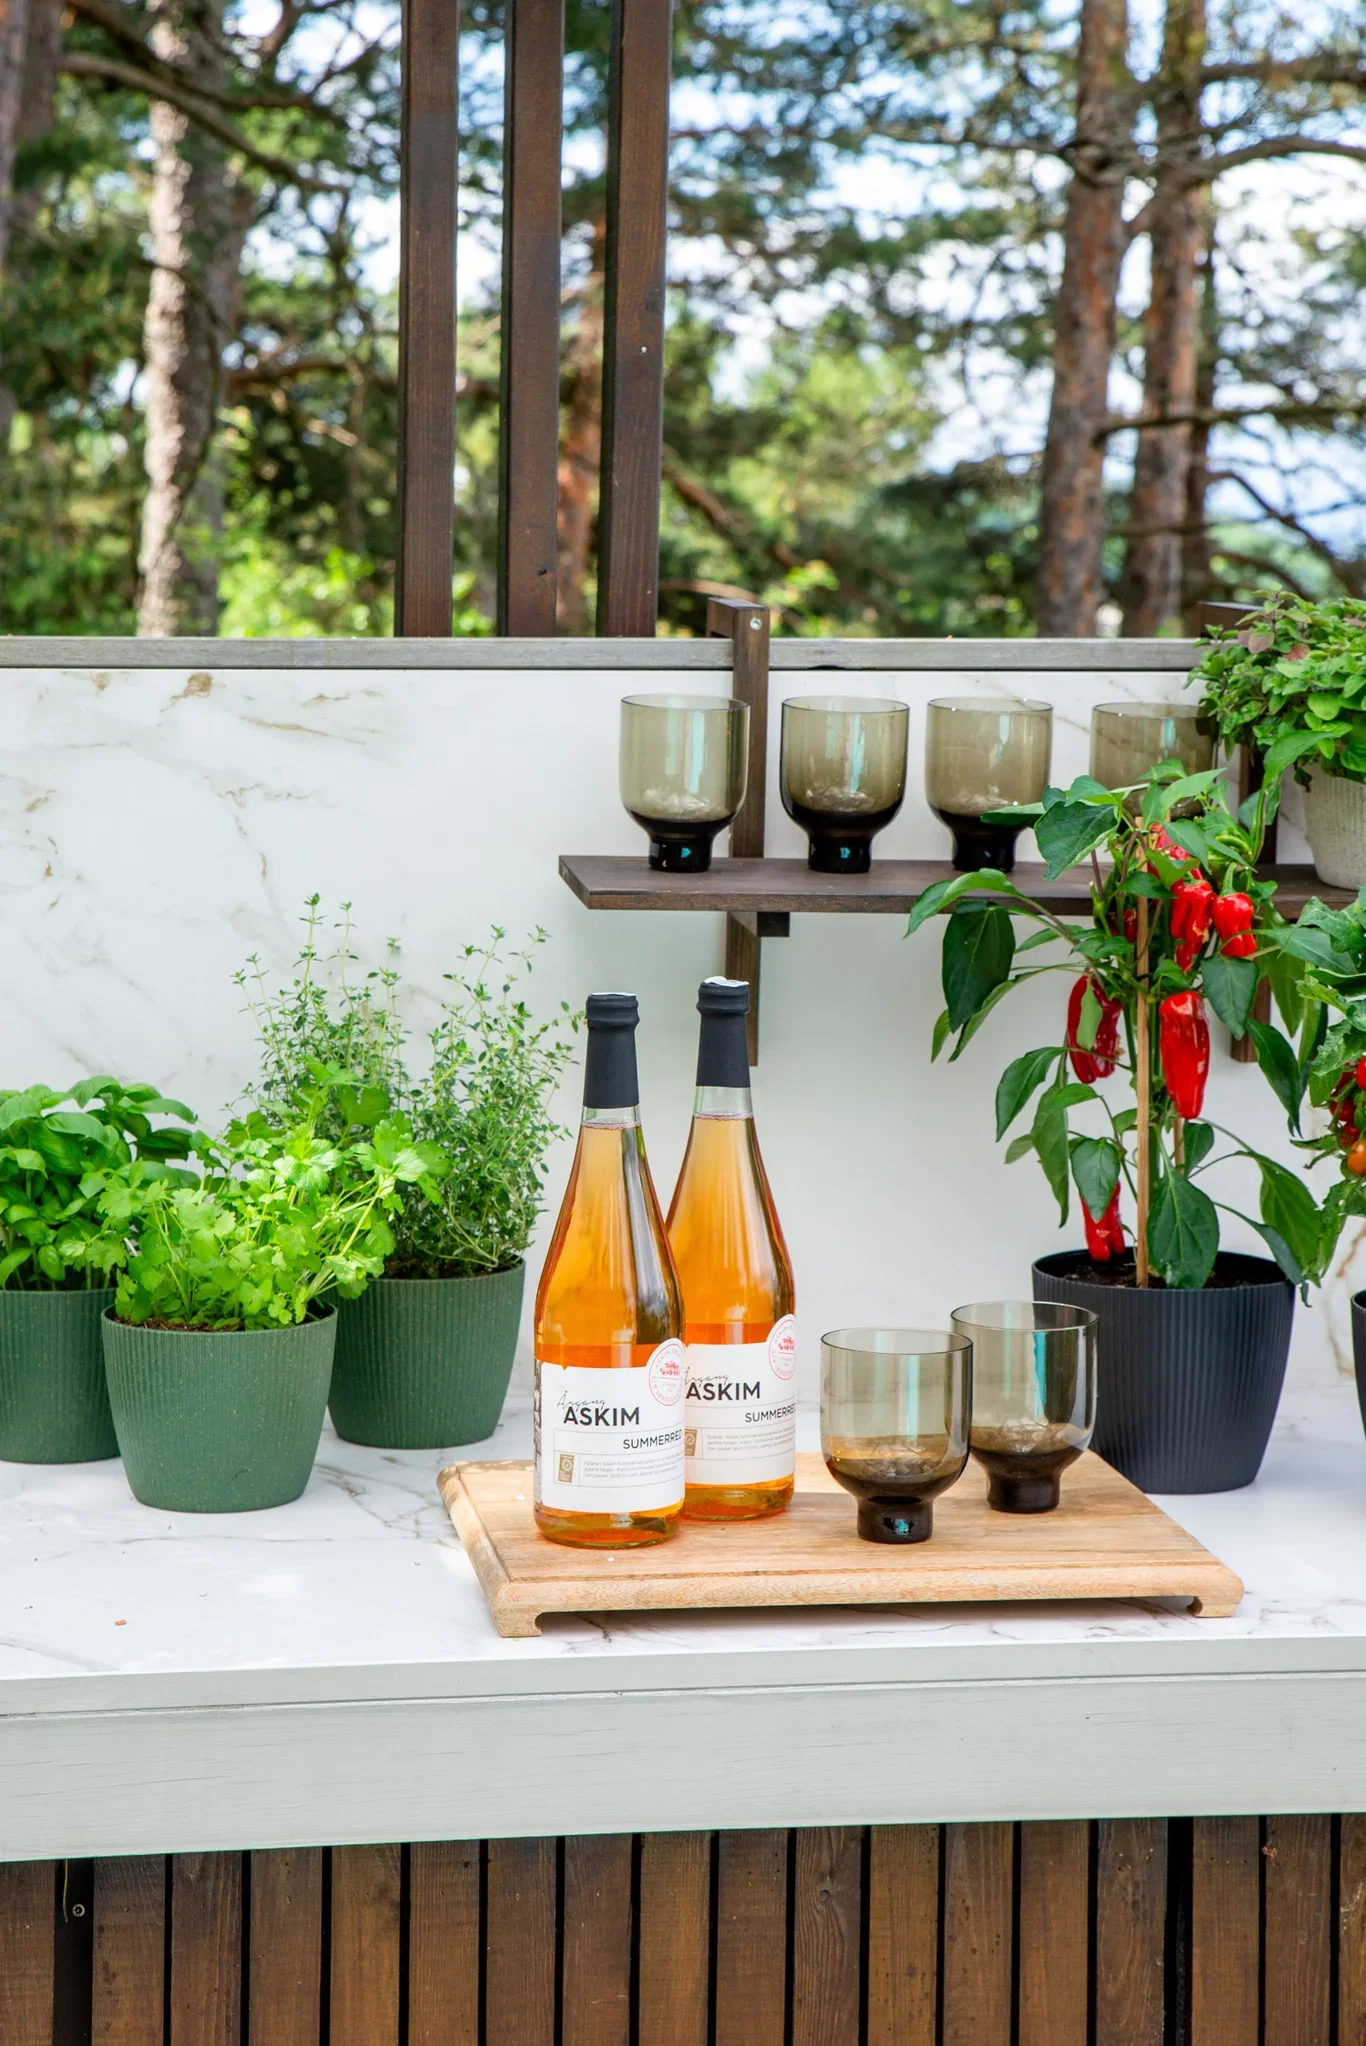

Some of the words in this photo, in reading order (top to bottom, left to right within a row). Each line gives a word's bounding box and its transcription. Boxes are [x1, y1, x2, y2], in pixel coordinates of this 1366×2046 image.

[556, 1390, 606, 1412] Årgang
[685, 1381, 760, 1401] ASKIM
[563, 1406, 640, 1426] ASKIM
